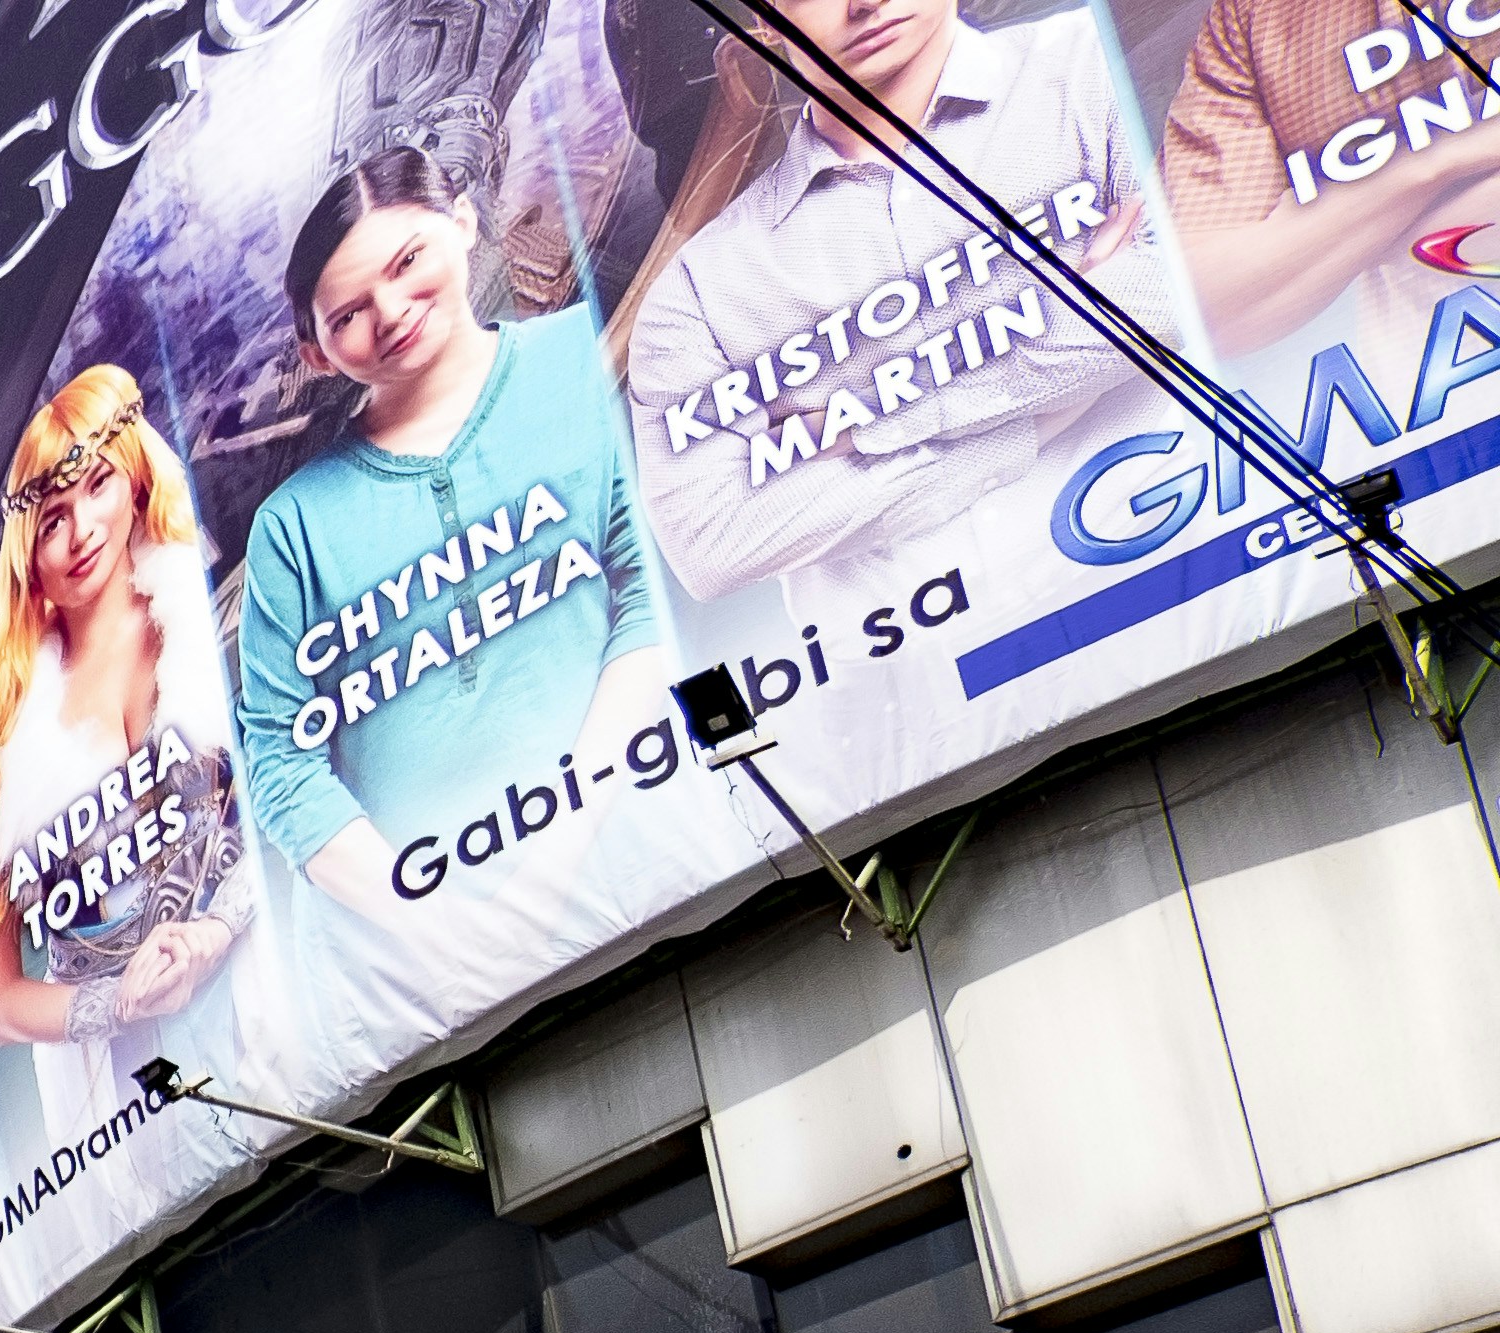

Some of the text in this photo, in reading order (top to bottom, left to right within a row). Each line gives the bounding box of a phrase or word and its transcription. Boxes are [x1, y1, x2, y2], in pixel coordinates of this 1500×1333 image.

[664, 179, 1106, 454] KRISTOFFER
[748, 285, 1047, 489] MARTIN
[292, 538, 603, 750] ORTALEZA
[295, 483, 567, 677] CHYNNA
[8, 728, 192, 906] ANDREA
[391, 566, 972, 900] Gabi-gbi sa
[21, 797, 189, 951] TORRES
